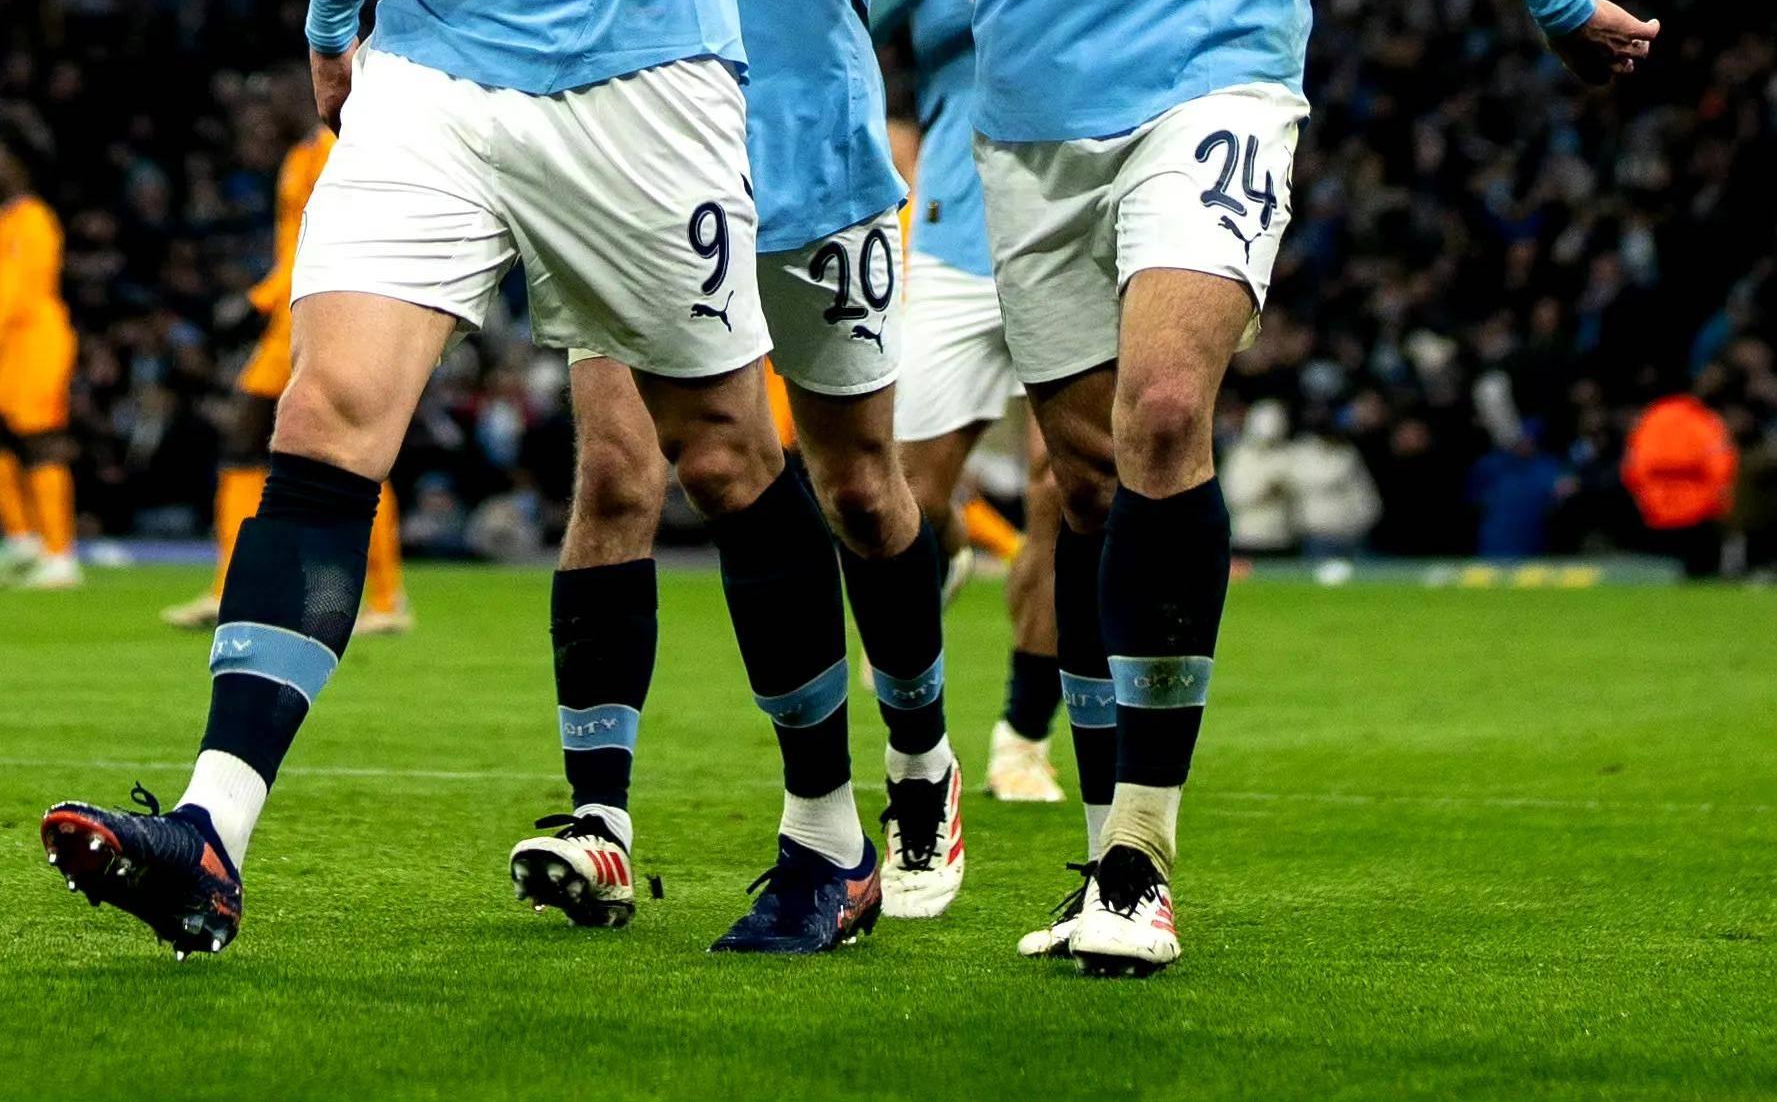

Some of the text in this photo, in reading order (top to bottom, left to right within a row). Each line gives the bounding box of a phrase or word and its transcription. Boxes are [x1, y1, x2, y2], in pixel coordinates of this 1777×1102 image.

[1194, 129, 1277, 231] 24
[687, 201, 730, 296] 9
[808, 228, 895, 325] 20
